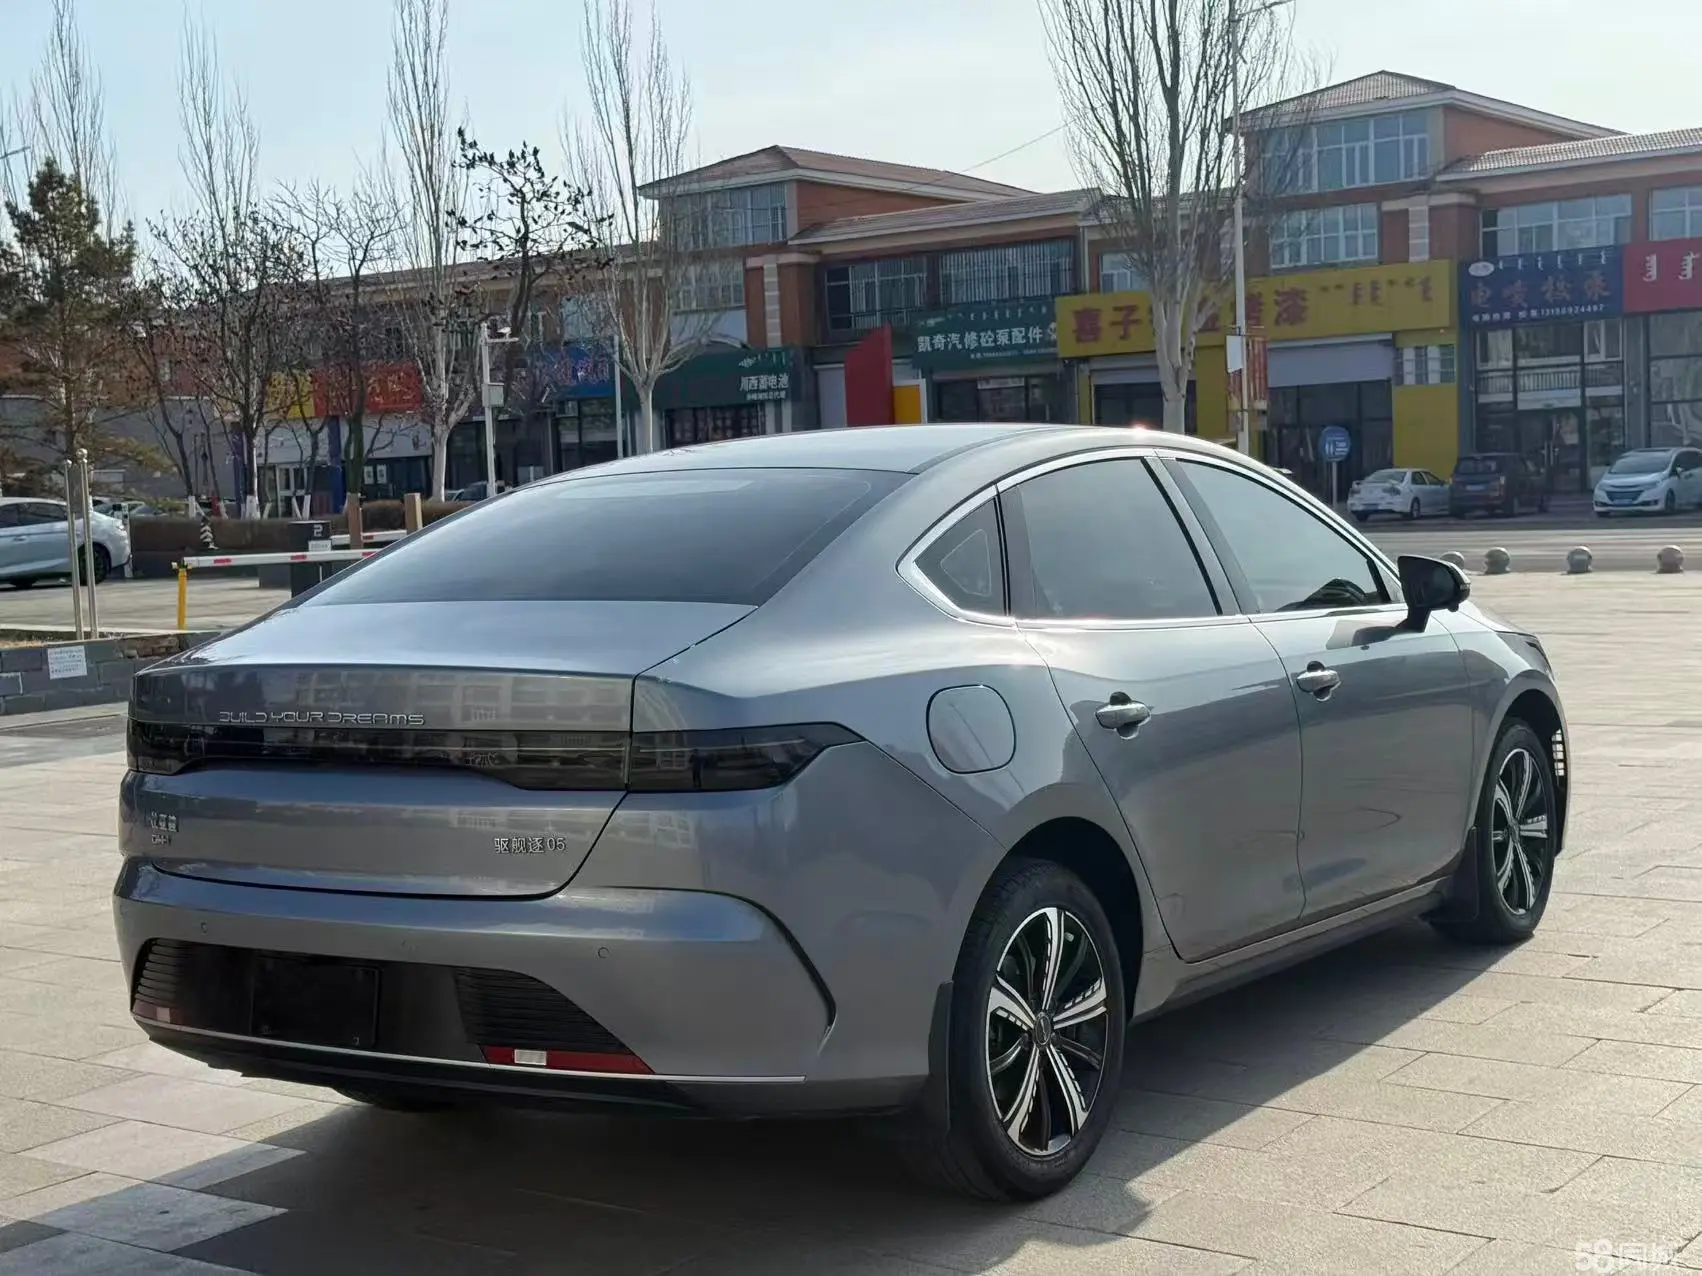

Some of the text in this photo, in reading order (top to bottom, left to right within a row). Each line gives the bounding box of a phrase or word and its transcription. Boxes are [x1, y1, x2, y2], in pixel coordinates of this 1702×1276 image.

[219, 711, 425, 725] BUILD YOUR DREAMS
